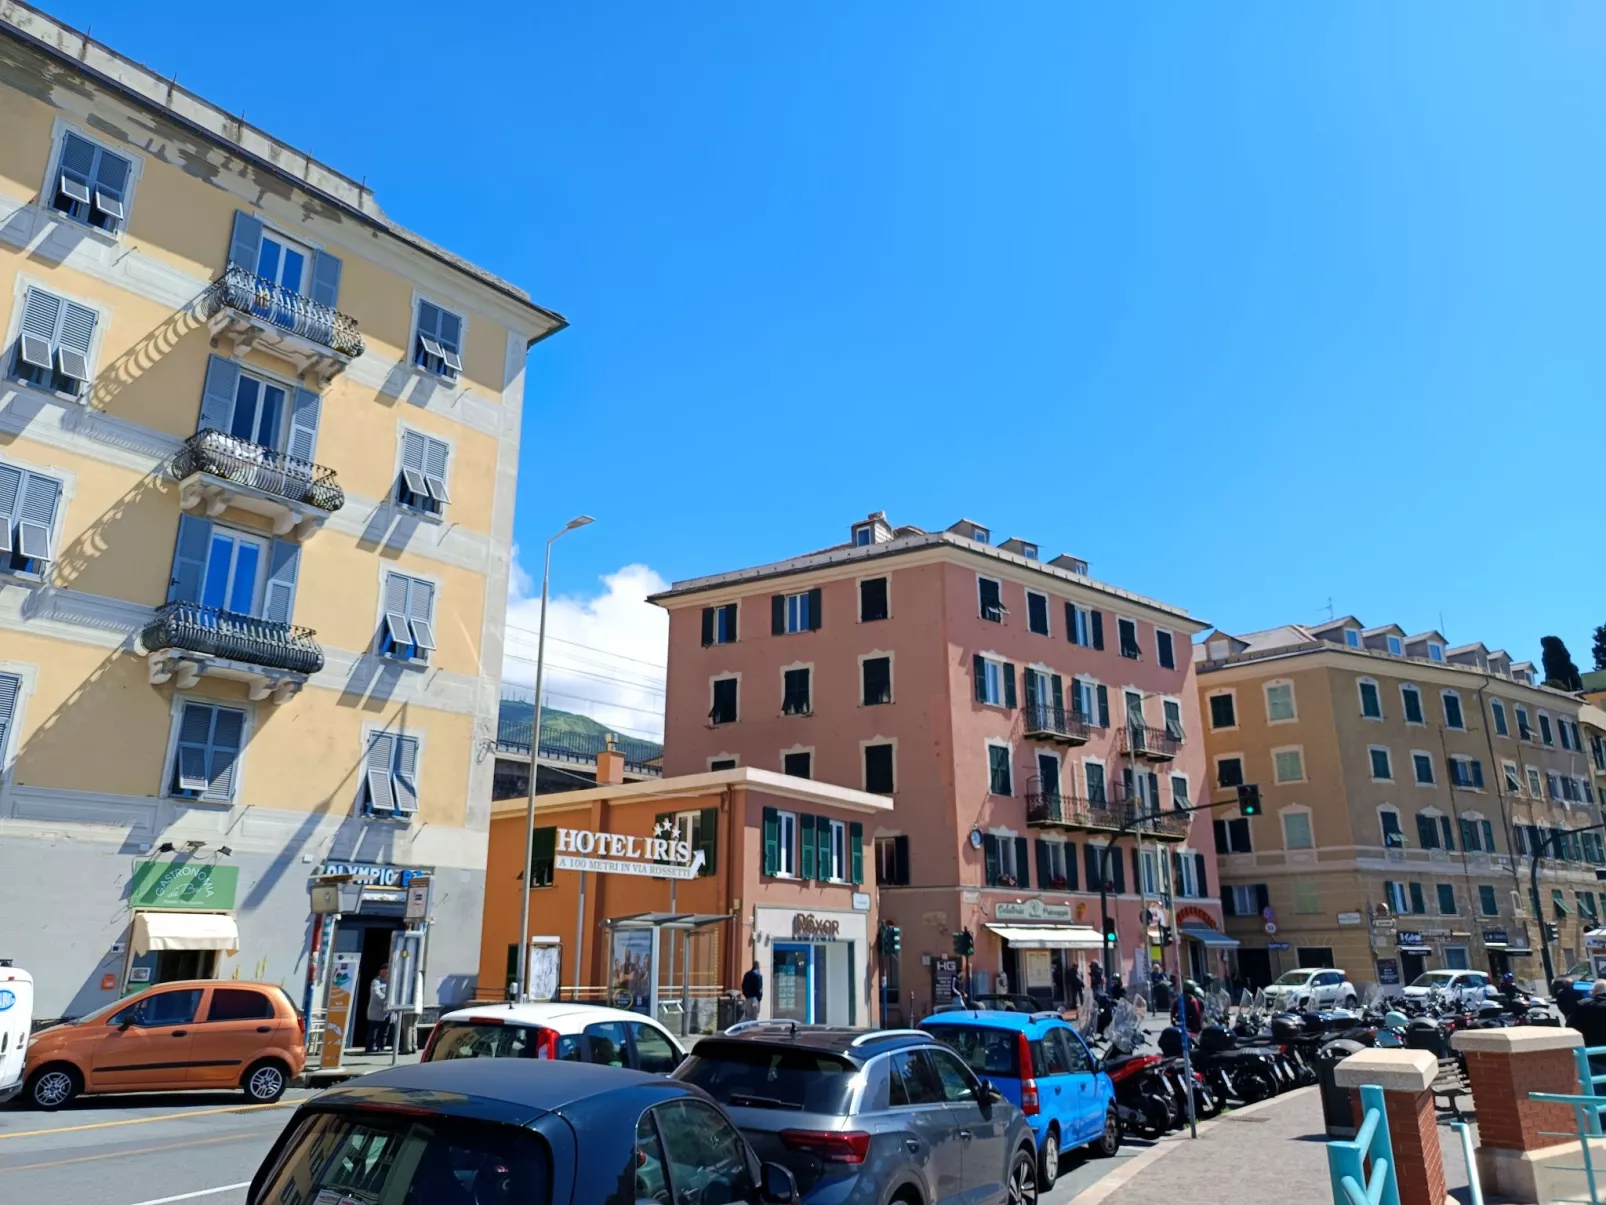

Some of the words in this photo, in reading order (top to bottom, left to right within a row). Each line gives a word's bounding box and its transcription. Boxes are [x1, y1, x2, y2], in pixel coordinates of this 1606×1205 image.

[556, 828, 641, 858] HOTEL
[644, 837, 690, 862] IRIS
[559, 858, 566, 866] A
[570, 859, 586, 868] 100
[589, 861, 618, 871] METRI
[621, 862, 630, 871] IN
[632, 864, 648, 873] VIA
[650, 866, 690, 877] ROSSETTI
[156, 867, 214, 897] GASTRONOMIA
[937, 961, 956, 971] HG
